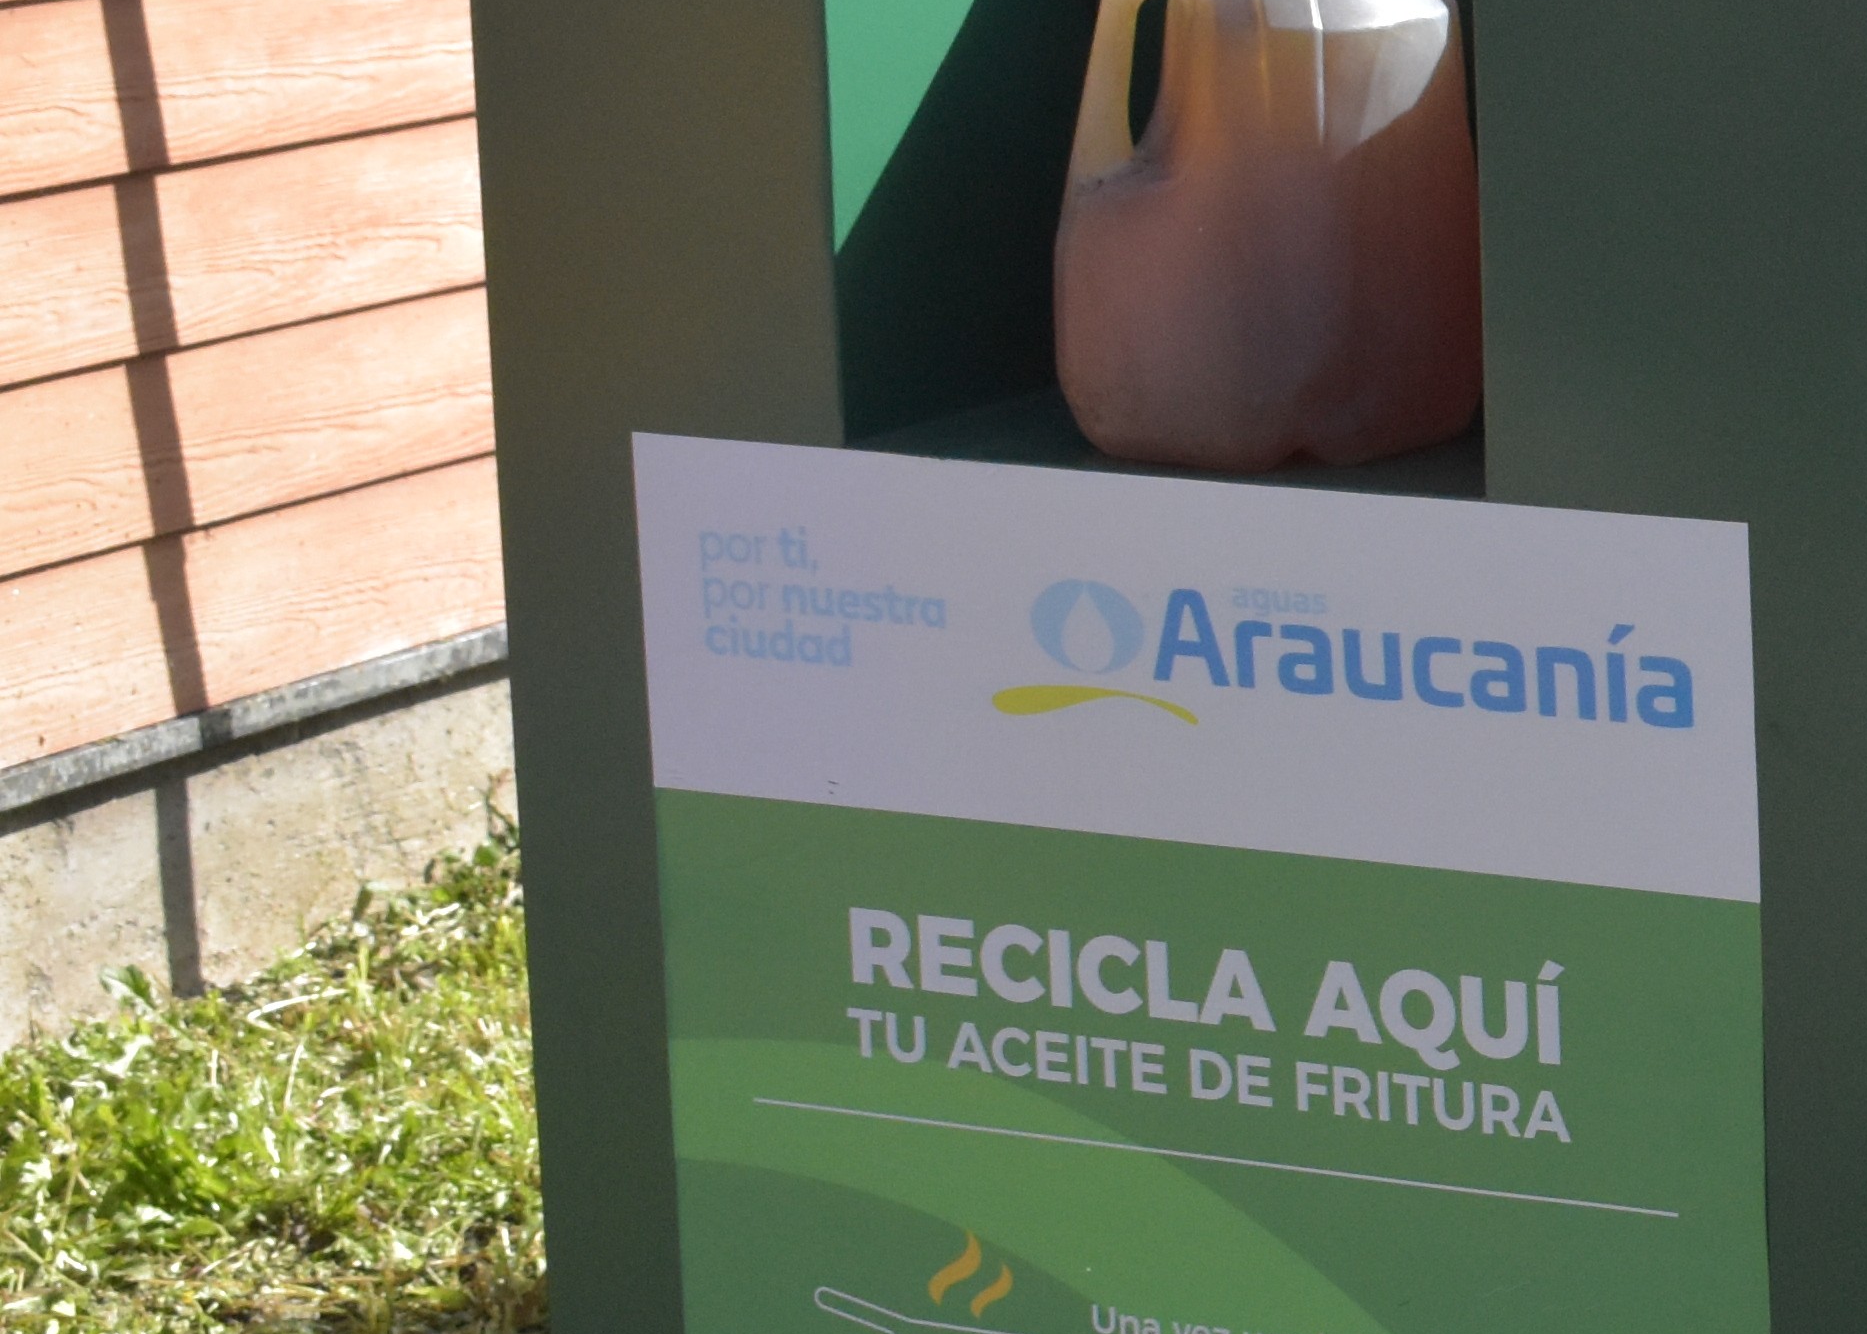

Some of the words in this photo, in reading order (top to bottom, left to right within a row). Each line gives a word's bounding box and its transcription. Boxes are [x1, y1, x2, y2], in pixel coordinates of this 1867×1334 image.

[699, 529, 767, 569] por
[778, 526, 818, 575] ti,
[702, 576, 771, 616] por
[782, 584, 946, 629] nuestra
[1231, 586, 1327, 616] aguas
[705, 617, 853, 667] ciudad
[1155, 590, 1694, 729] Araucanía
[850, 908, 1275, 1031] RECICLA
[1305, 961, 1563, 1070] AQUÍ
[847, 1008, 925, 1063] TU
[948, 1022, 1166, 1094] ACEITE
[1190, 1049, 1272, 1107] DE
[1296, 1062, 1570, 1142] FRITURA
